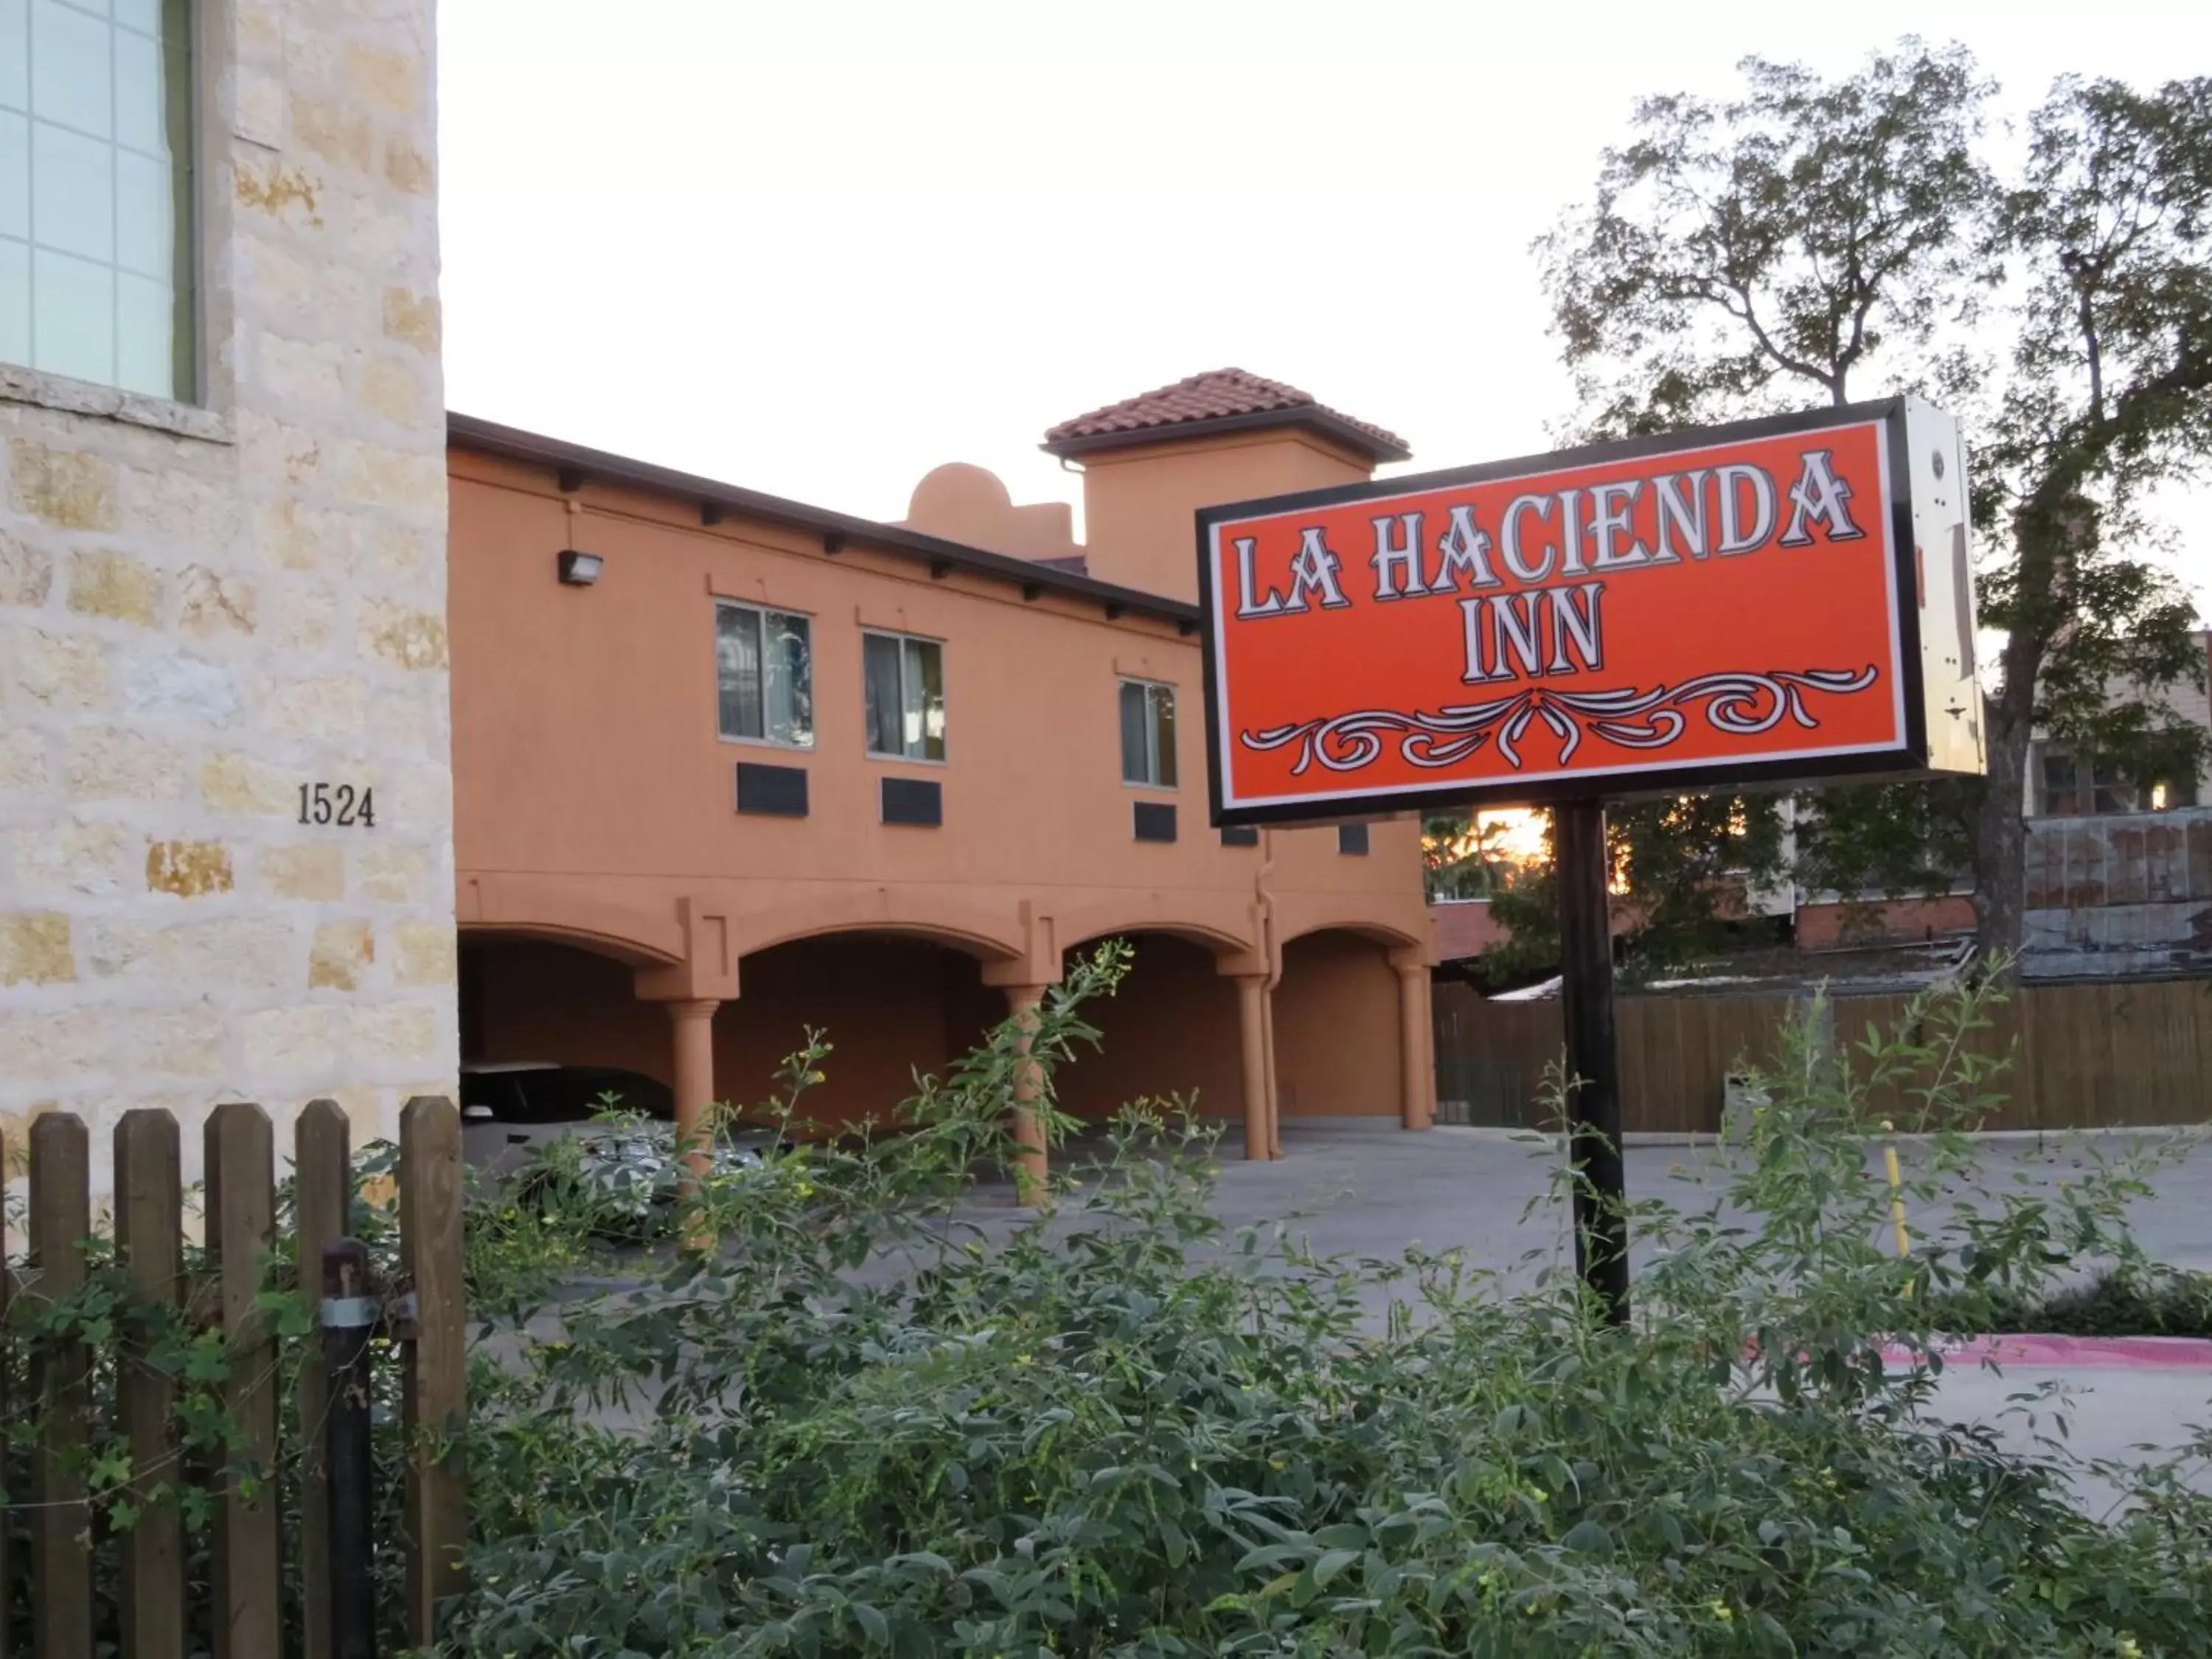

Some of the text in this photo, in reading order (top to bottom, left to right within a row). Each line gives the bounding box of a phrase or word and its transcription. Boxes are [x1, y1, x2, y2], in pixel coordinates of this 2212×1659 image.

[1232, 449, 1865, 619] LA HACIENDA
[1457, 581, 1604, 684] INN
[297, 782, 376, 827] 1524
